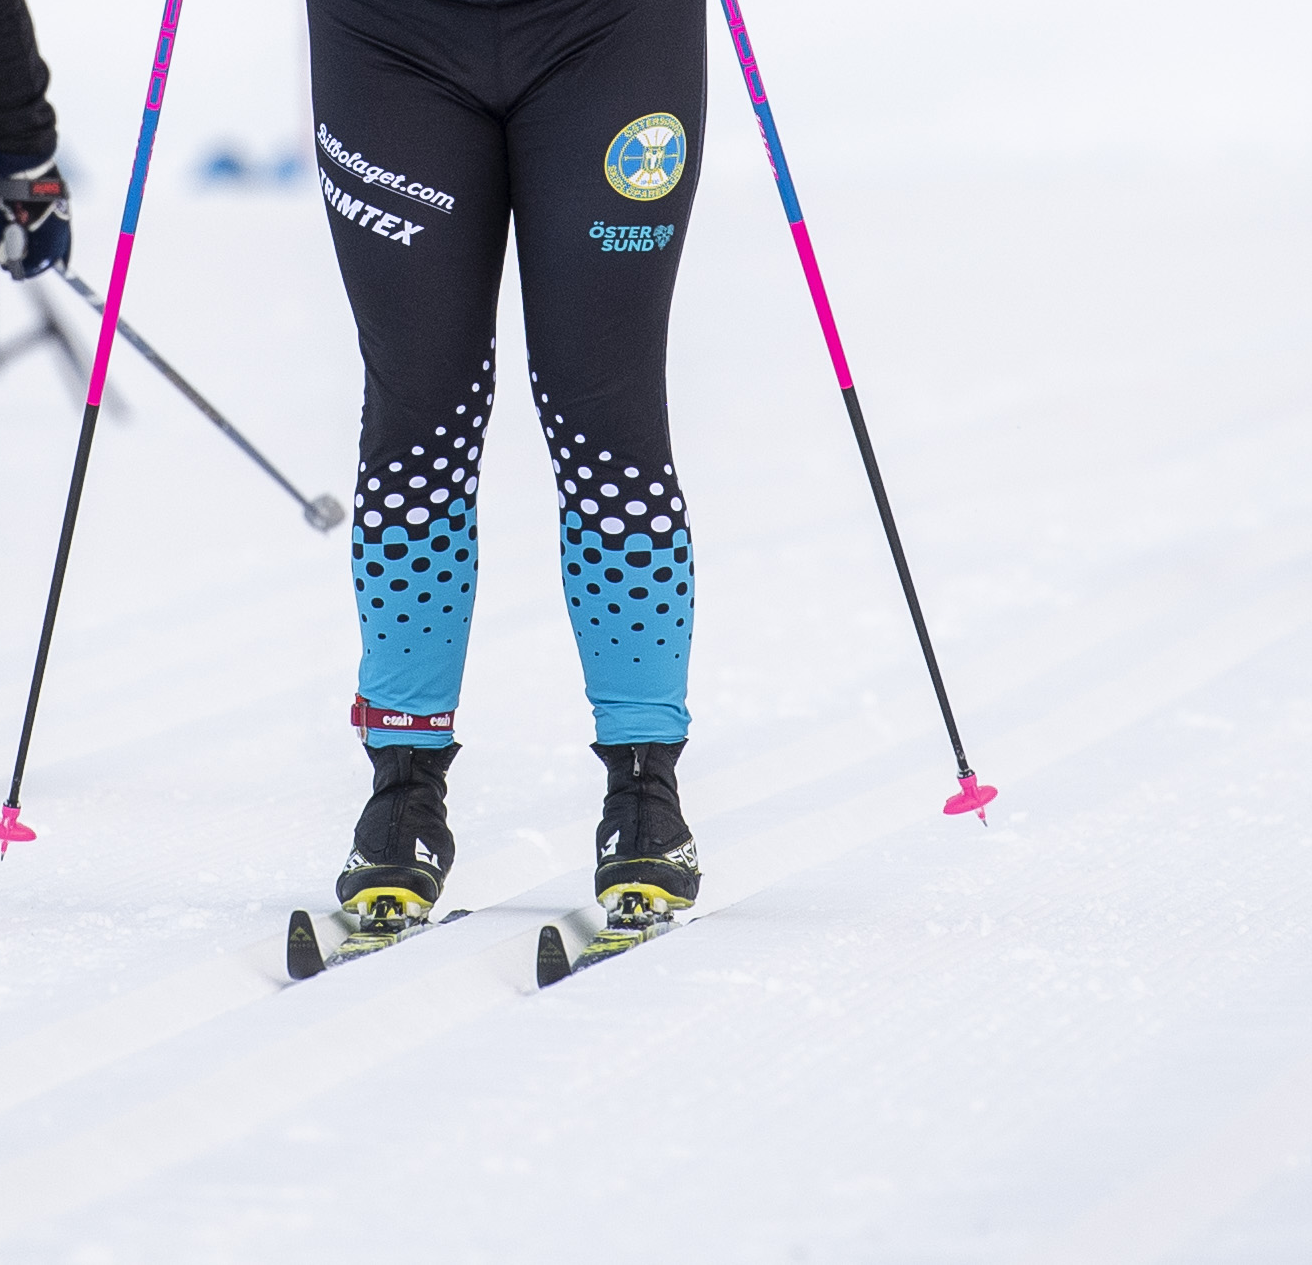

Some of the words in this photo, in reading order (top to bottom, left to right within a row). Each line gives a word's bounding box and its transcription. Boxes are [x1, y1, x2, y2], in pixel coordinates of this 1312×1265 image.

[317, 122, 455, 211] Bilbolaget.com
[319, 166, 425, 247] TRIMTEX
[589, 220, 652, 240] ÖSTER
[601, 239, 655, 252] SUND
